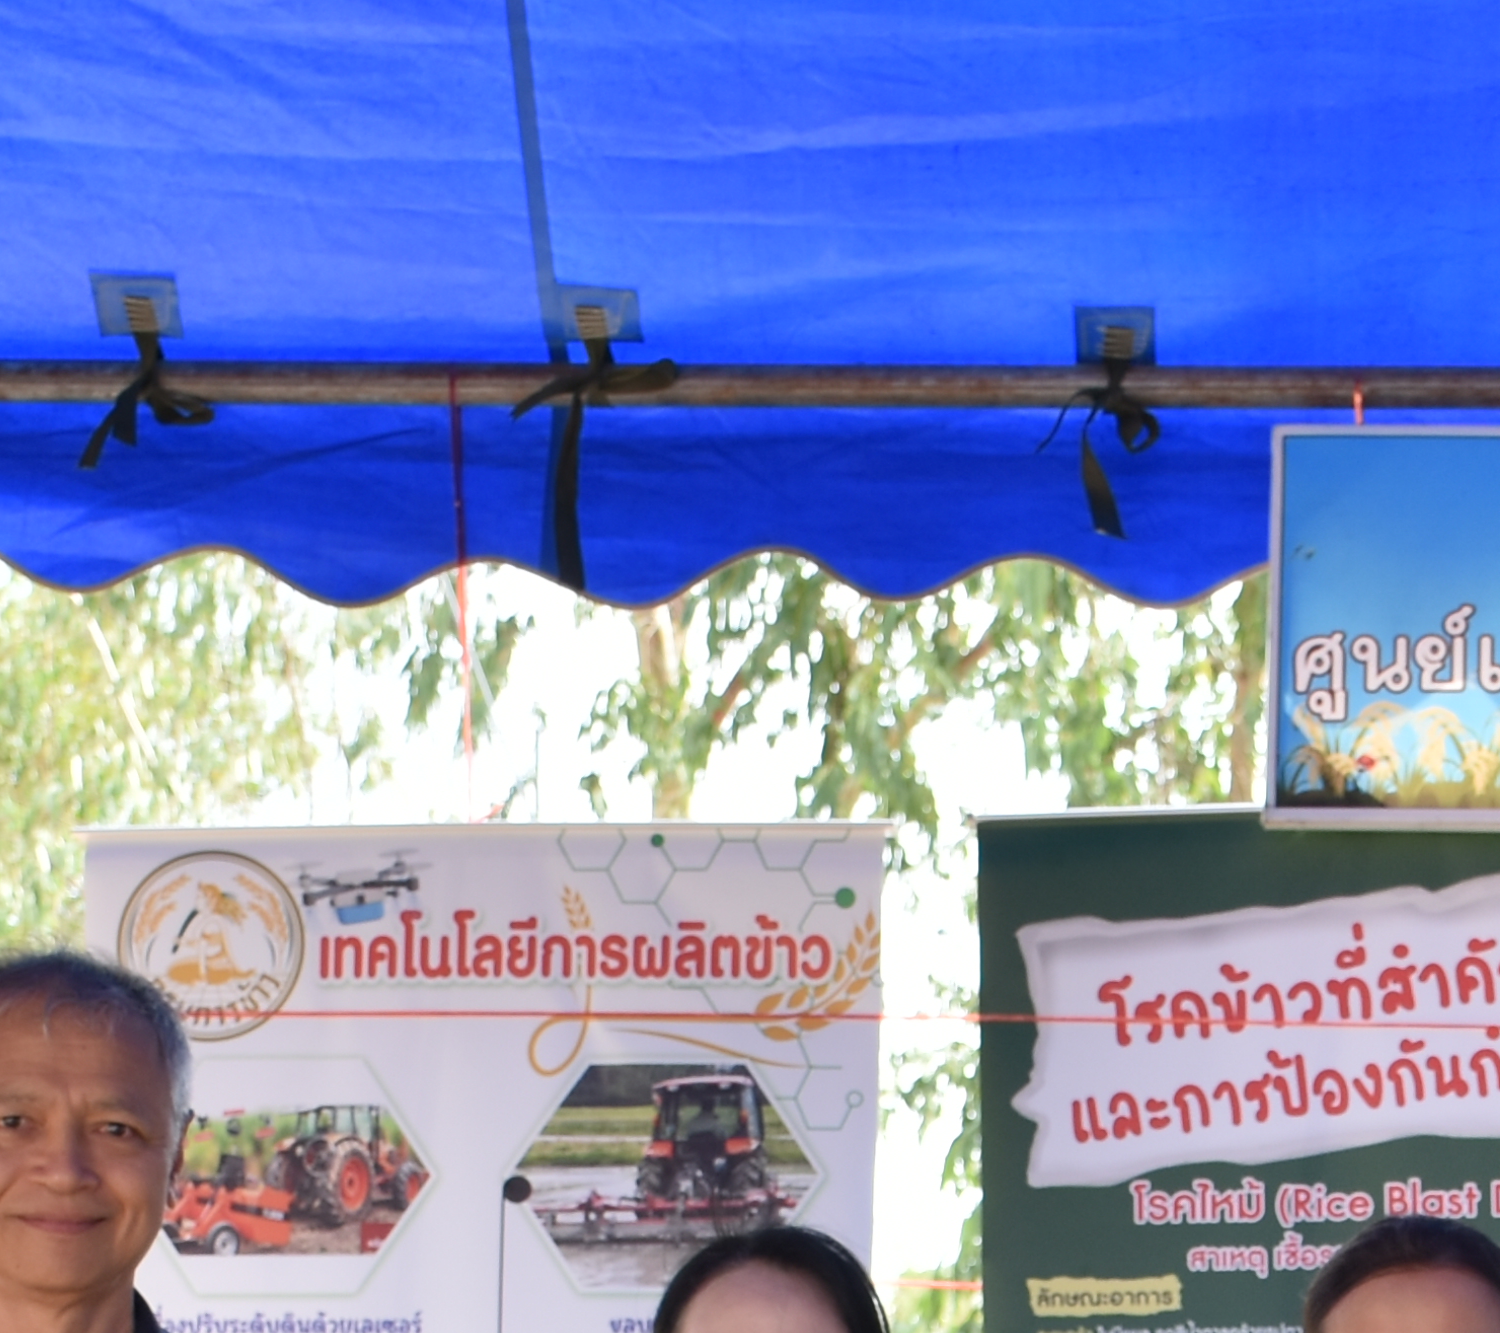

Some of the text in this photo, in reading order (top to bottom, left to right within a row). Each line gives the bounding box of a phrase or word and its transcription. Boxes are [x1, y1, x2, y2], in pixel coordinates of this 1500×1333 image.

[319, 910, 833, 982] เทคโนโลยีการผลิตข้าว
[1131, 1178, 1266, 1224] โรคไหม้
[1275, 1184, 1374, 1227] (Rice
